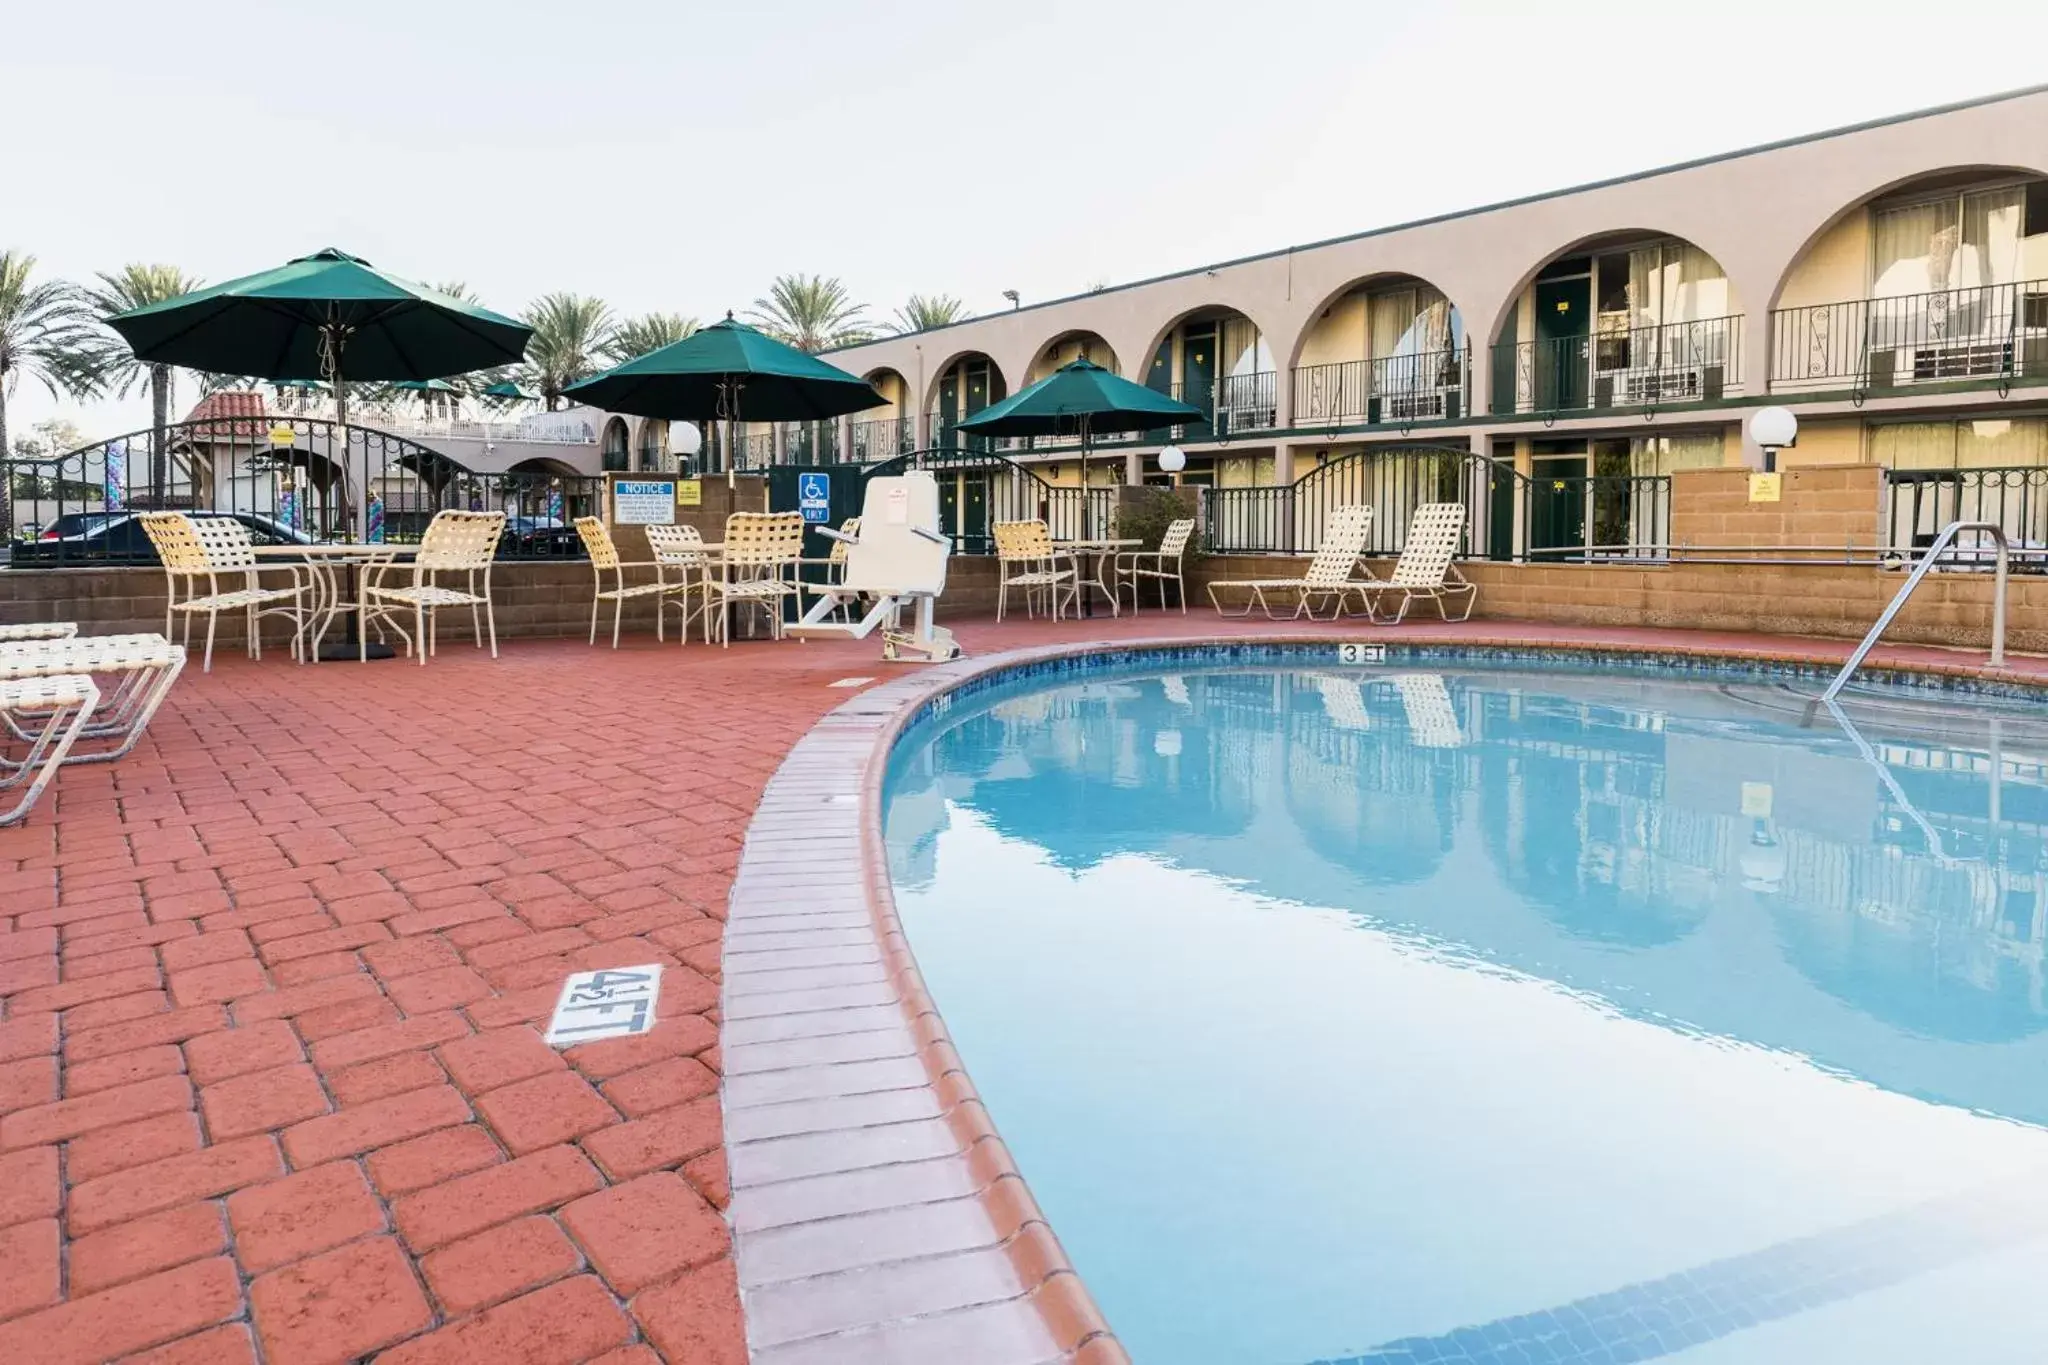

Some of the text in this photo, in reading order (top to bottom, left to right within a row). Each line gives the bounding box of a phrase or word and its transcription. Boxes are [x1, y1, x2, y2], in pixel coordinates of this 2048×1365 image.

[625, 483, 665, 494] NOTICE
[1344, 645, 1357, 662] 3
[555, 998, 649, 1035] FT
